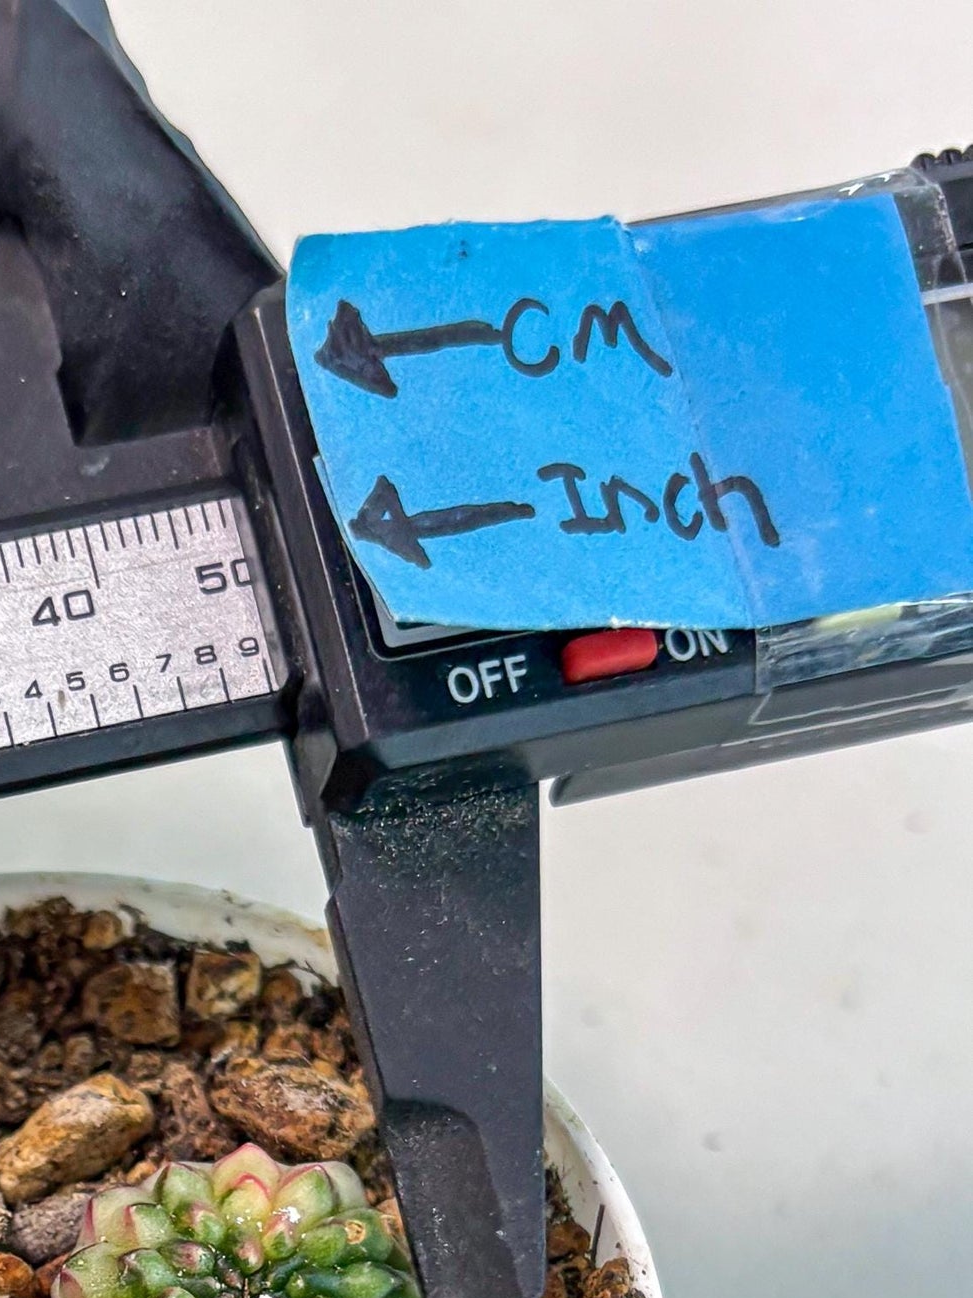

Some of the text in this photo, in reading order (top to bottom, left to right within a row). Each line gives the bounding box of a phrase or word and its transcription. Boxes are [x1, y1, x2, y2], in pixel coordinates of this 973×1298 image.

[537, 452, 780, 548] Inch
[32, 589, 95, 627] 40
[196, 558, 252, 594] 50
[25, 680, 43, 699] 4
[66, 671, 86, 691] 5
[109, 662, 130, 682] 6
[155, 654, 173, 673] 7
[195, 646, 216, 665] 8
[239, 637, 260, 657] 9
[664, 629, 728, 662] ON
[447, 655, 527, 705] OFF
